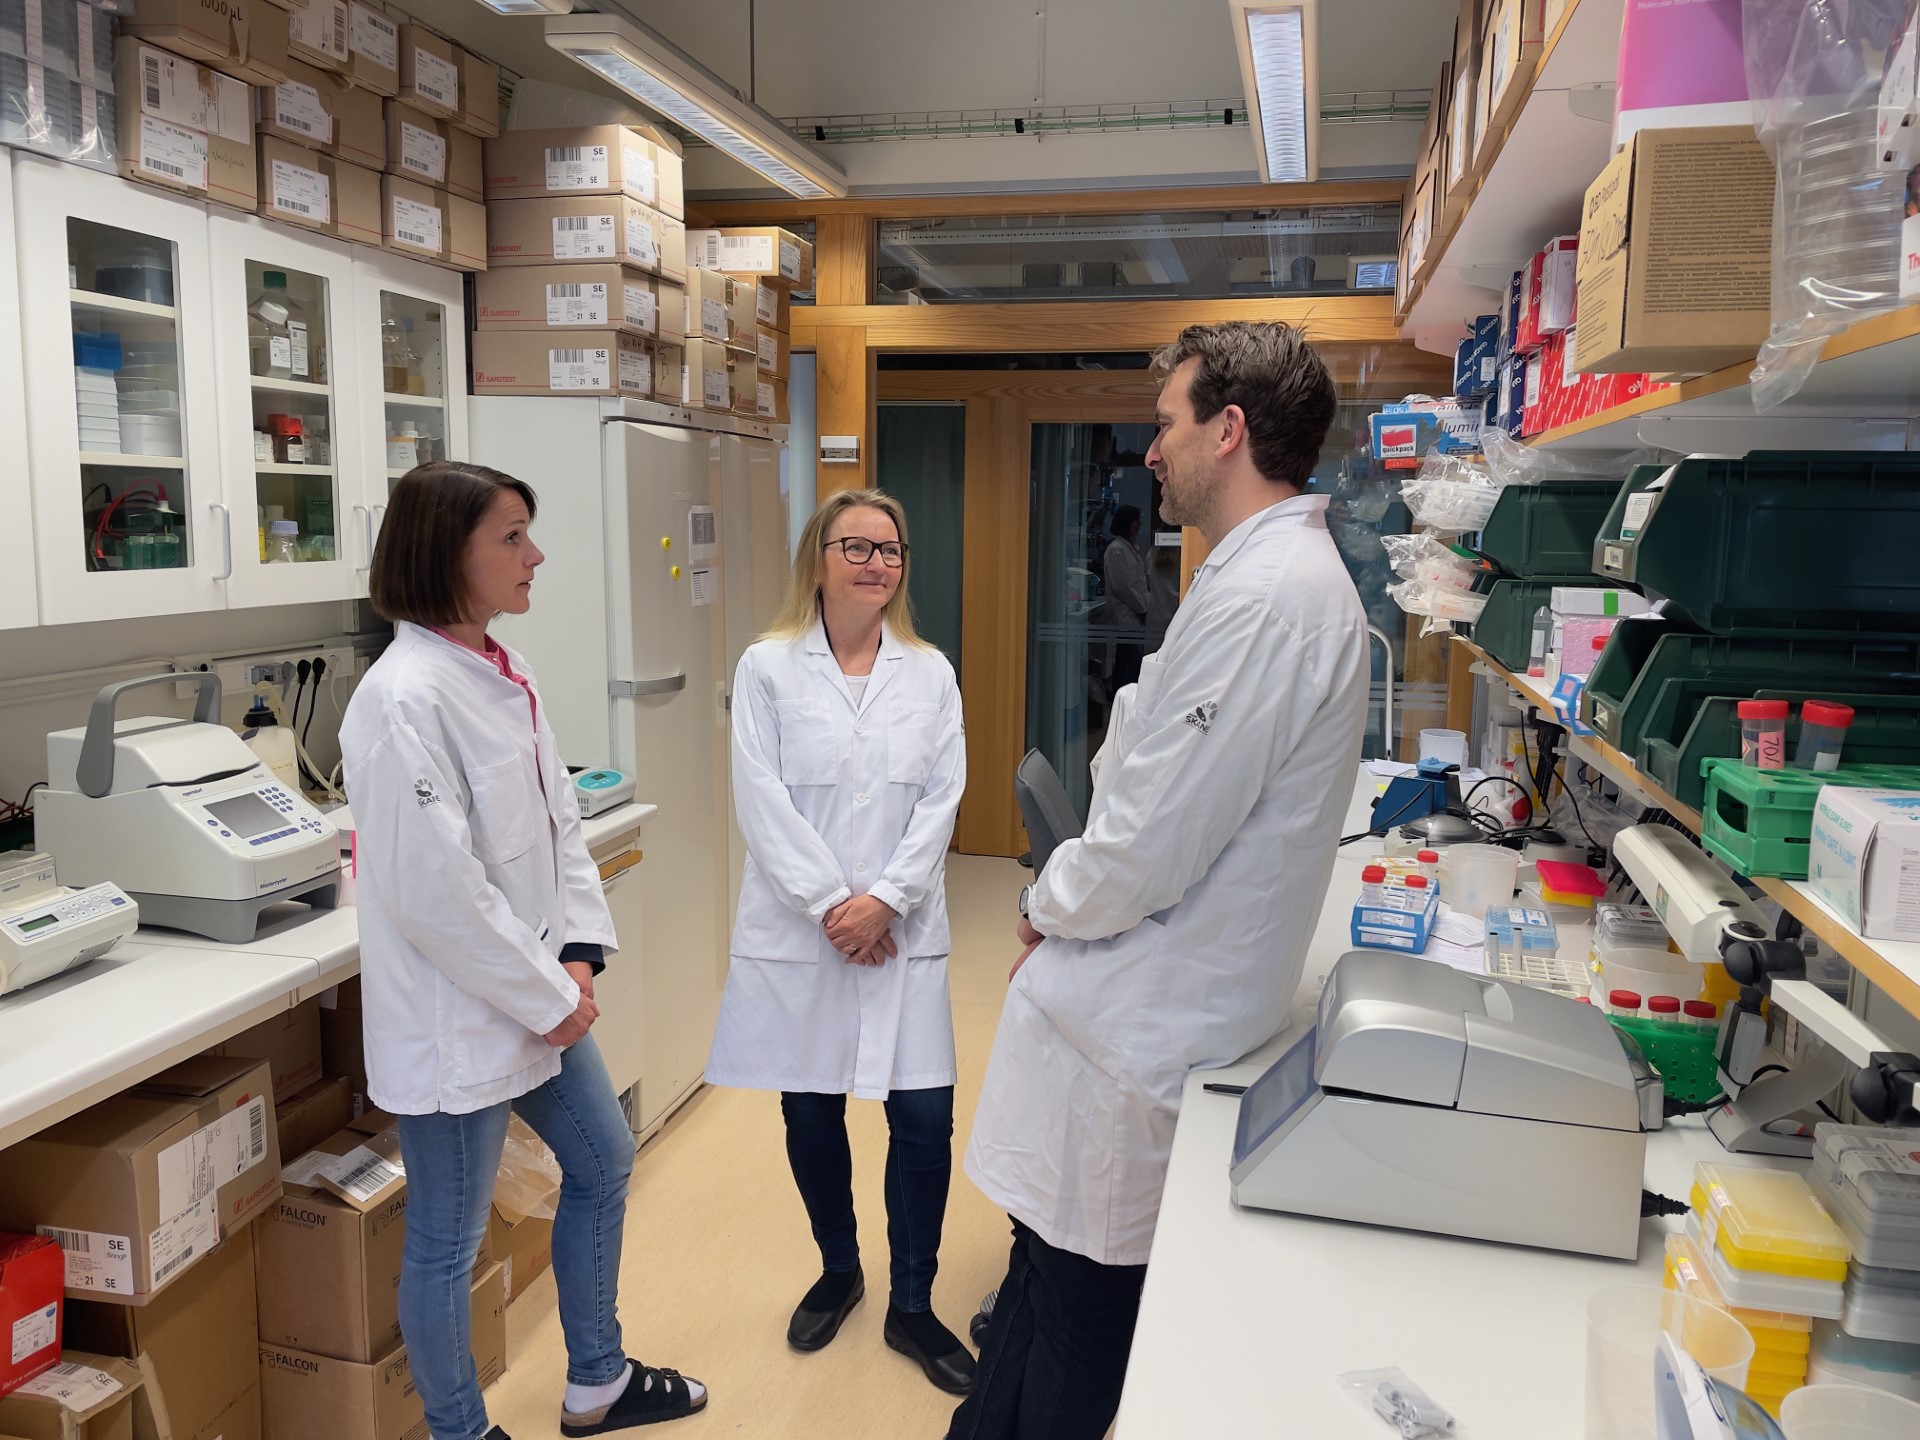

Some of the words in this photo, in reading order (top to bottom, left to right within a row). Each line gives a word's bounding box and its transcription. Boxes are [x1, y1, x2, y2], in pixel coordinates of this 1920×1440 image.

[593, 147, 604, 155] SE
[600, 217, 611, 225] SE
[592, 284, 604, 292] SE
[589, 312, 597, 320] SE
[1480, 317, 1499, 336] QIAGEN
[595, 350, 606, 358] SE
[592, 377, 600, 385] SE
[1382, 446, 1415, 454] quickpack
[245, 1177, 276, 1206] SARSTEDT
[280, 1205, 325, 1225] FALCON
[108, 1239, 125, 1251] SE
[85, 1276, 93, 1286] 21
[105, 1278, 116, 1289] SE
[276, 1353, 319, 1373] FALCON
[95, 1372, 113, 1387] SE
[57, 1389, 73, 1399] SE
